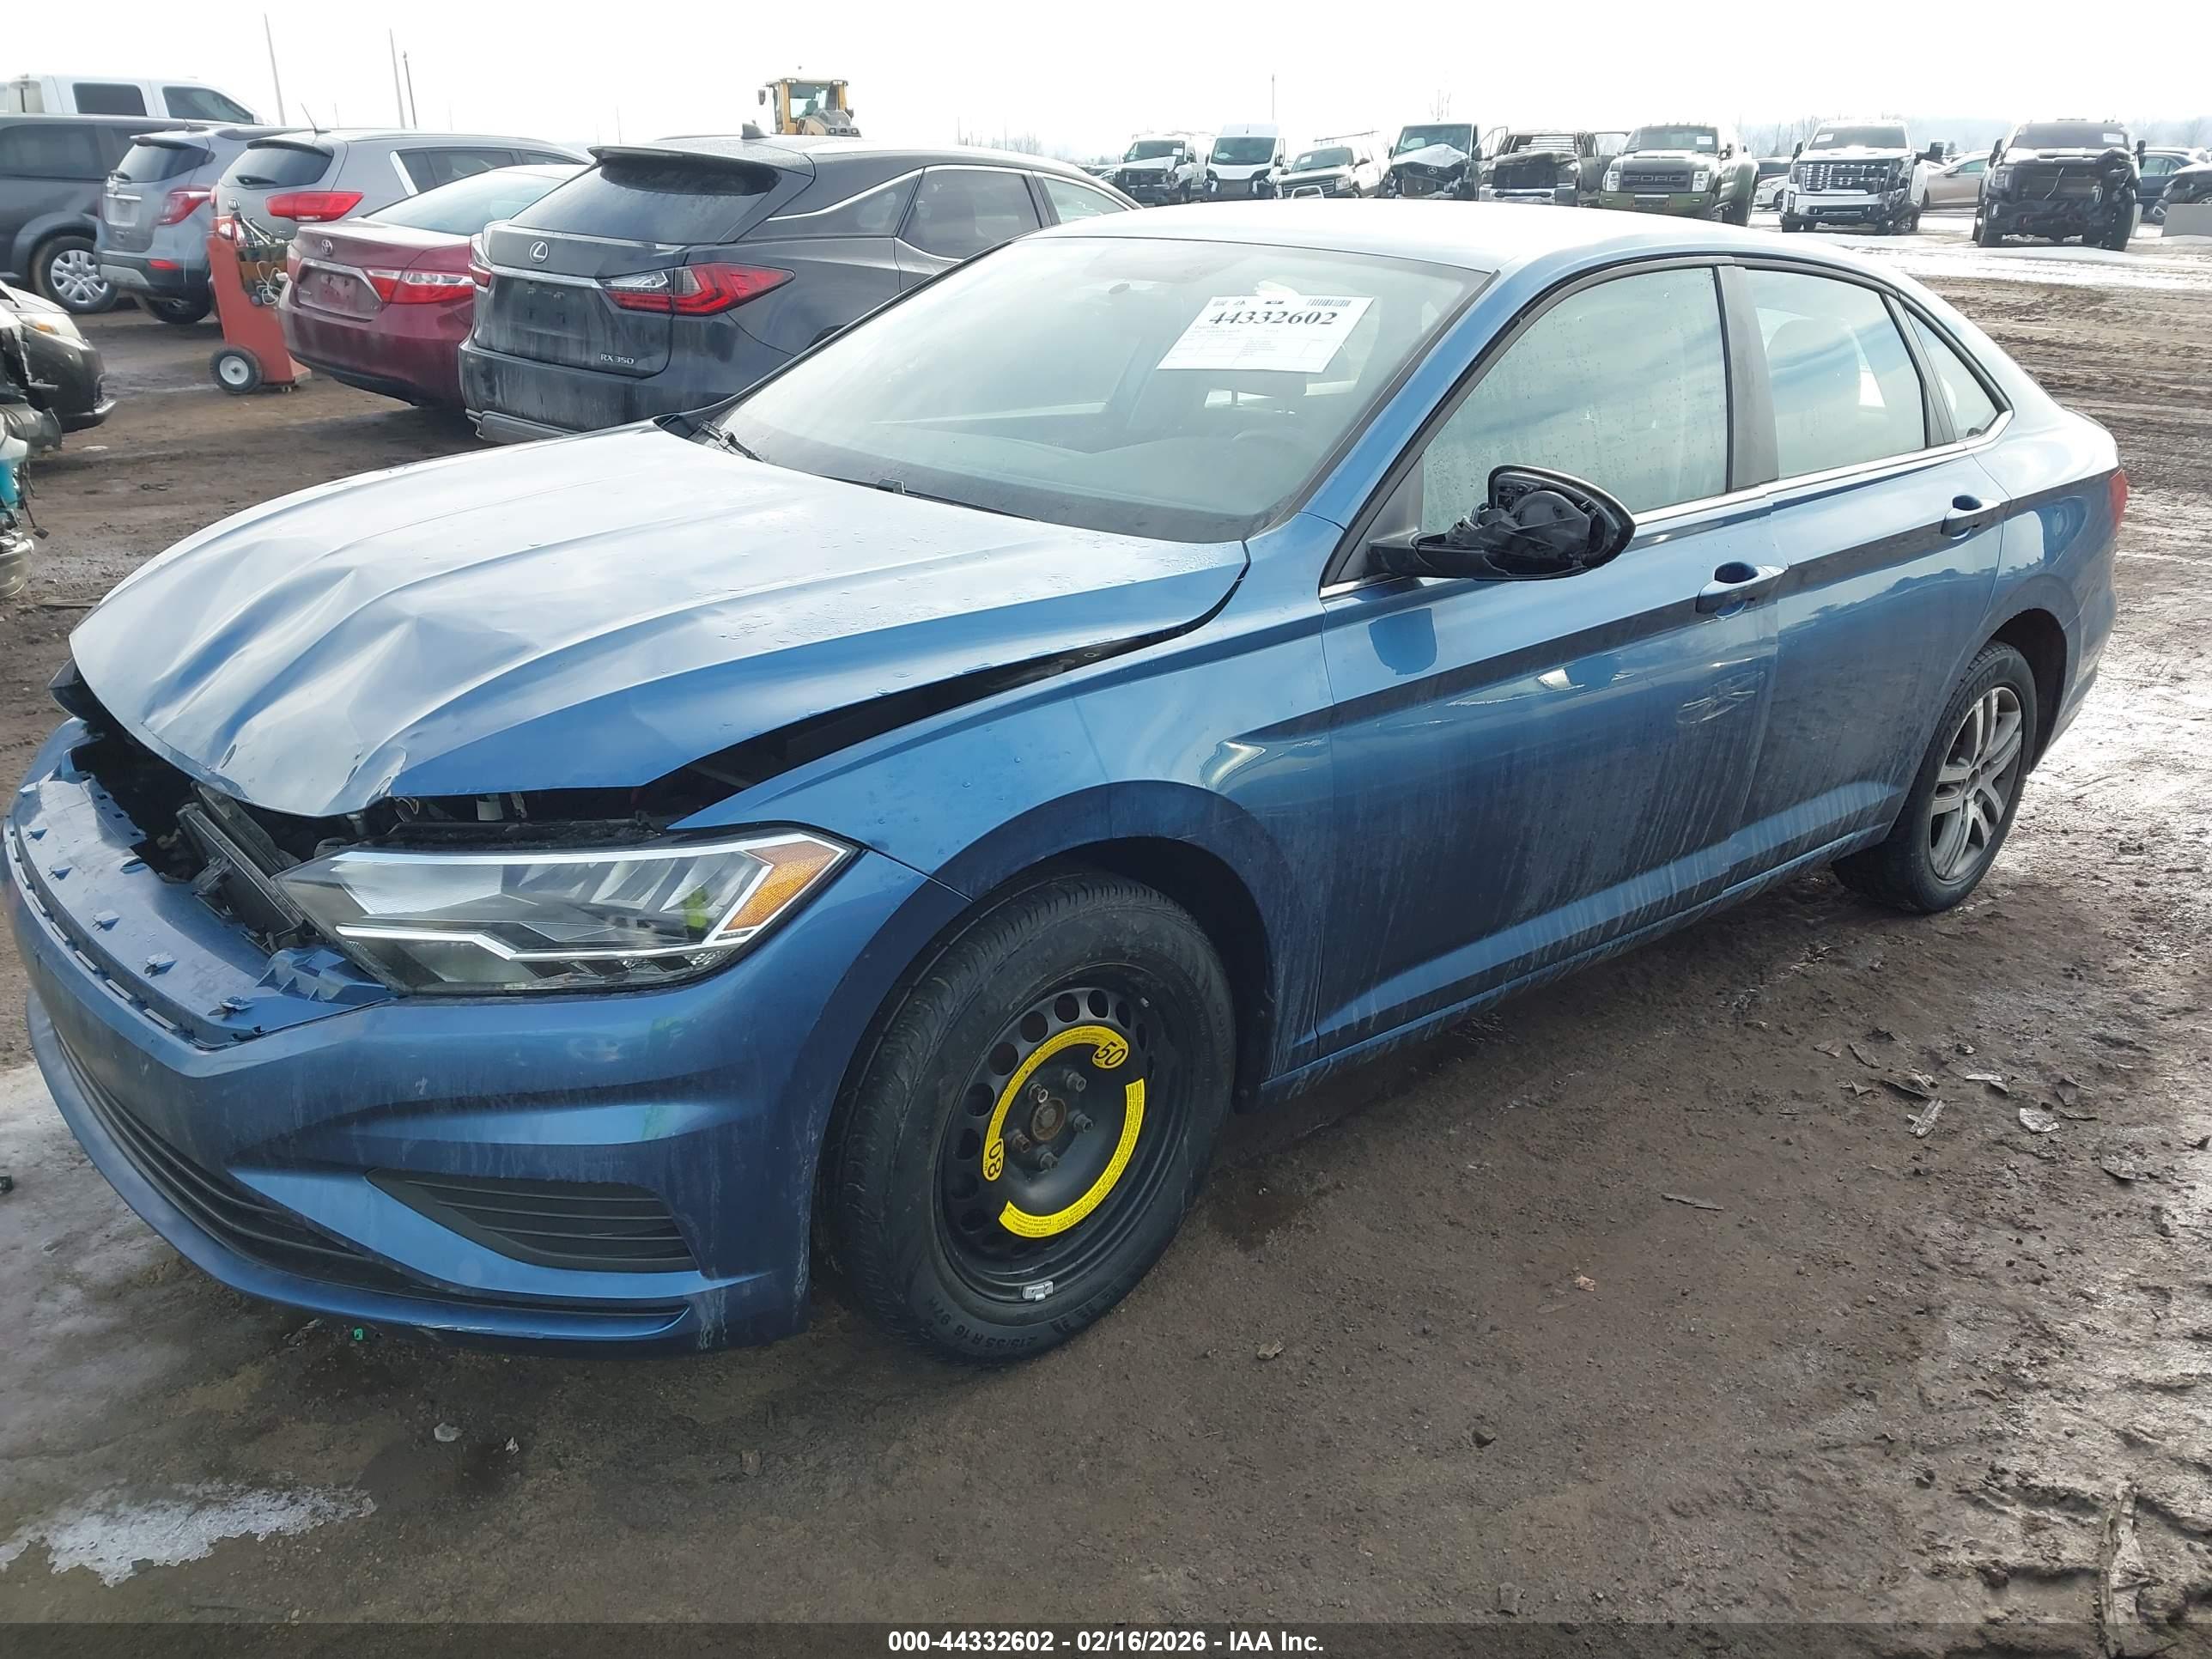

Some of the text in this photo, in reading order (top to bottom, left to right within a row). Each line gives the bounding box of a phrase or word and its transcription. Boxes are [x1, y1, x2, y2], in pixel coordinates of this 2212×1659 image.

[1208, 311, 1338, 325] 44332602
[600, 353, 635, 365] RX 350
[1094, 1041, 1126, 1066] 50
[988, 1140, 1002, 1177] 80
[954, 1324, 971, 1339] 16
